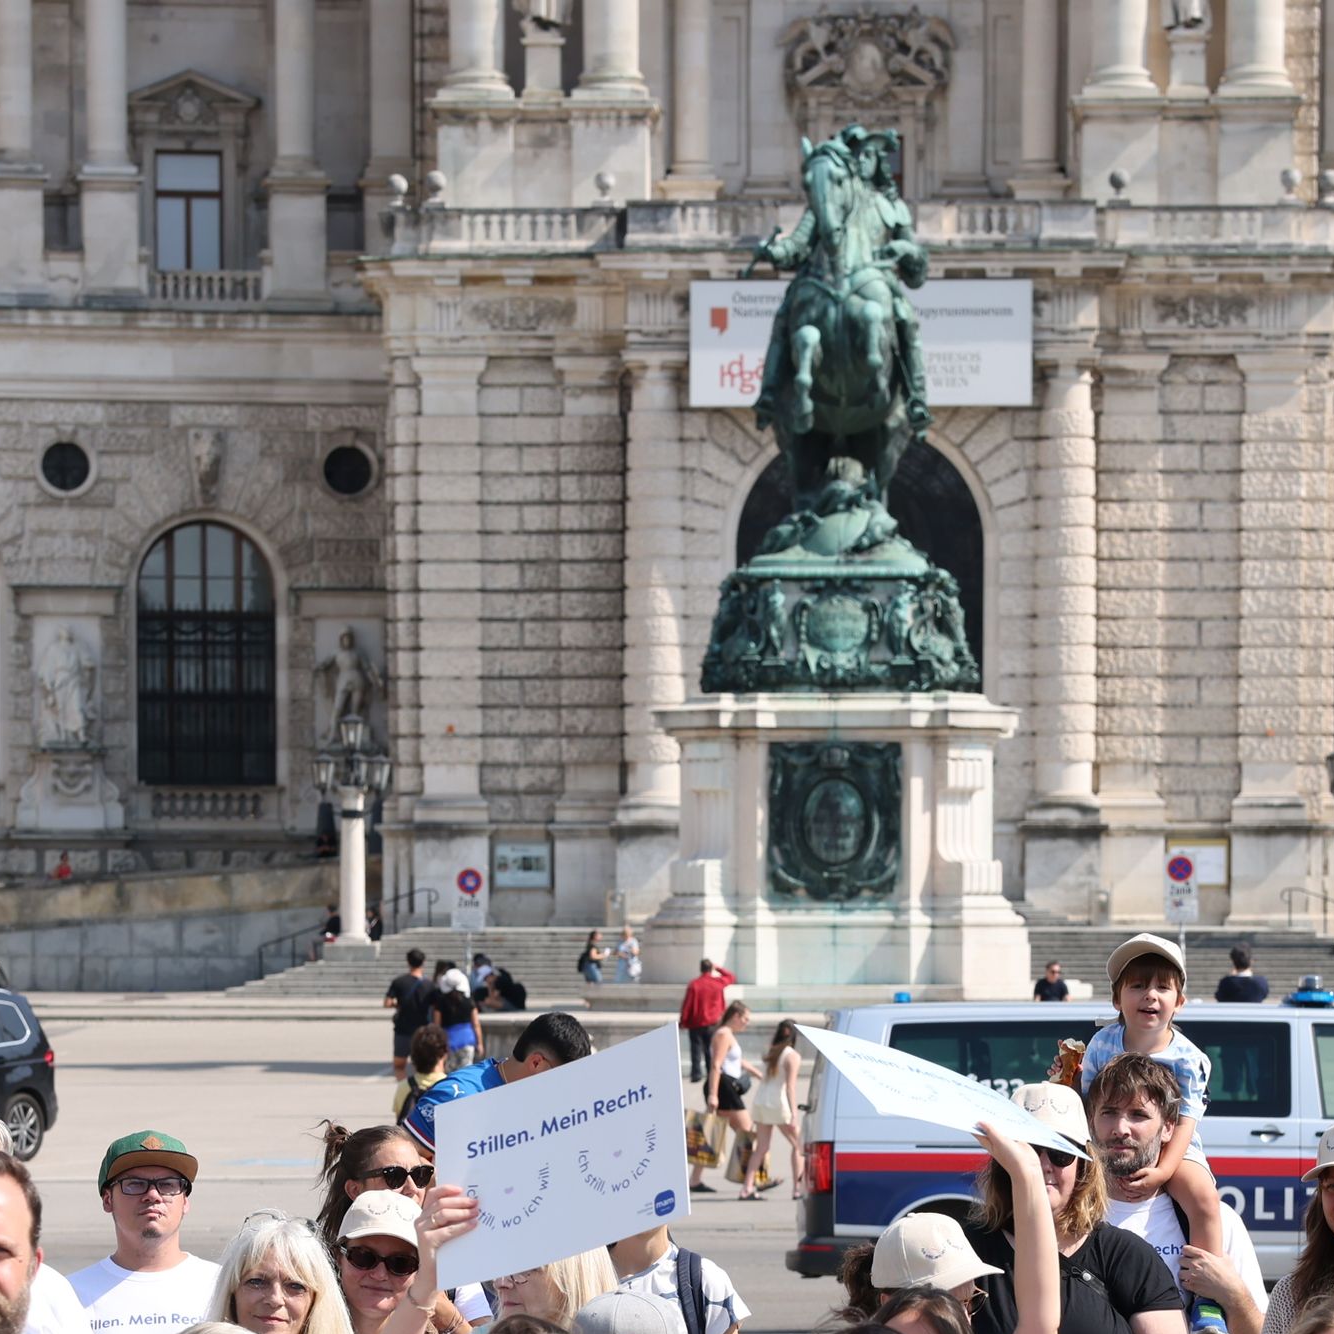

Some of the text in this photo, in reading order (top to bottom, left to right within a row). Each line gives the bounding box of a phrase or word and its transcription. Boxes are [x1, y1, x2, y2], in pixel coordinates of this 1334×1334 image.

[467, 1084, 653, 1159] Stillen. Mein Recht.
[578, 1124, 656, 1195] Ich still, wo ich will.
[502, 1162, 550, 1229] wo ich will.
[1218, 1185, 1314, 1221] OLI
[128, 1313, 166, 1325] Mein
